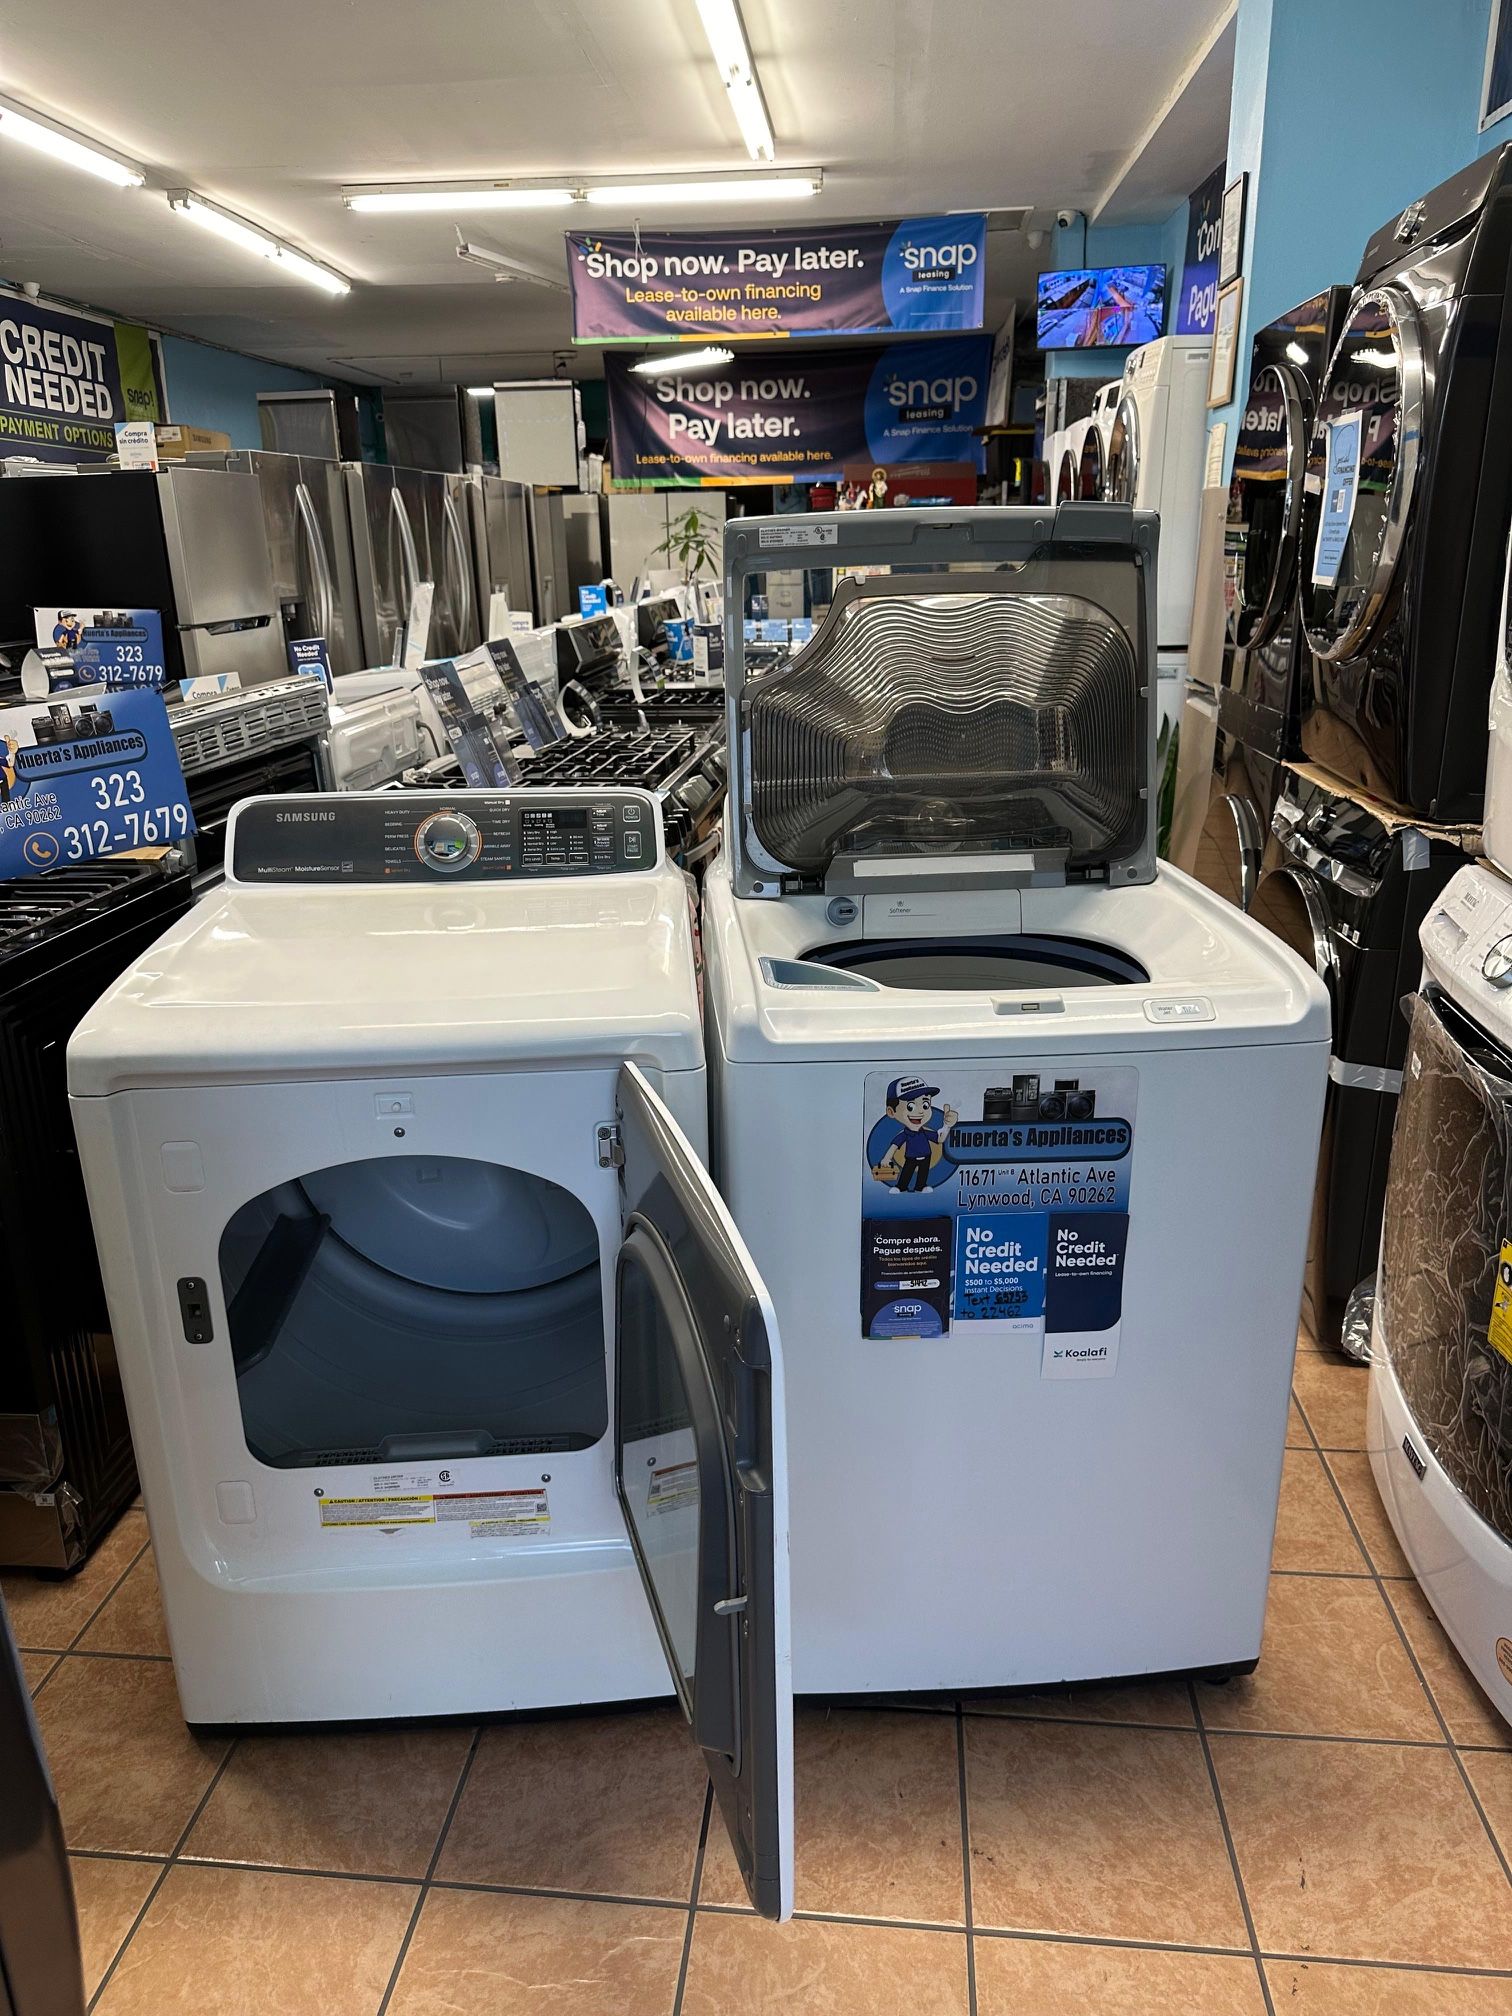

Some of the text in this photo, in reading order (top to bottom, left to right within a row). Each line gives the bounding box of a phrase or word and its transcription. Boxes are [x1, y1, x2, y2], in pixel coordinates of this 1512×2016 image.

[586, 247, 864, 284] Shop now. Pay later.
[904, 243, 977, 275] snap
[918, 270, 950, 279] leasing
[626, 282, 821, 303] Lease-to-own financing
[666, 305, 782, 322] available here.
[0, 319, 106, 382] CREDIT
[4, 363, 114, 419] NEEDED
[656, 376, 811, 408] Shop now.
[889, 376, 978, 412] snap
[906, 407, 944, 419] leasing
[0, 415, 114, 448] PAYMENT OPTIONS
[125, 430, 148, 438] Compra
[668, 412, 800, 446] Pay later.
[883, 425, 974, 438] A Snap Finance Solution
[128, 436, 149, 444] crédito
[635, 450, 834, 465] Lease-to-own financing available here.
[116, 645, 143, 662] 323
[99, 665, 163, 681] 312-7679
[16, 735, 144, 770] Huerta's Appliances
[91, 770, 146, 811] 323
[34, 792, 58, 807] Ave
[5, 805, 62, 829] CA 90262
[276, 811, 336, 822] SAMSUNG
[64, 803, 188, 860] 312-7679
[950, 1126, 1127, 1148] Huerta's Appliances
[959, 1169, 996, 1187] 11671
[1017, 1167, 1081, 1186] Atlantic
[1086, 1166, 1116, 1183] Ave
[957, 1187, 1116, 1211] Lynwood, CA 90262
[876, 1236, 940, 1246] Compre ahora.
[966, 1227, 994, 1242] No
[1057, 1228, 1079, 1241] No
[873, 1245, 943, 1256] Pague después.
[965, 1241, 1022, 1259] Credit
[1056, 1241, 1106, 1254] Credit
[965, 1257, 1038, 1275] Needed
[1055, 1253, 1117, 1267] Needed
[994, 1277, 1019, 1285] $5,000
[964, 1285, 1023, 1294] Instant Decisions
[894, 1304, 922, 1315] snap
[960, 1307, 975, 1319] to
[1065, 1347, 1107, 1358] Koalafi
